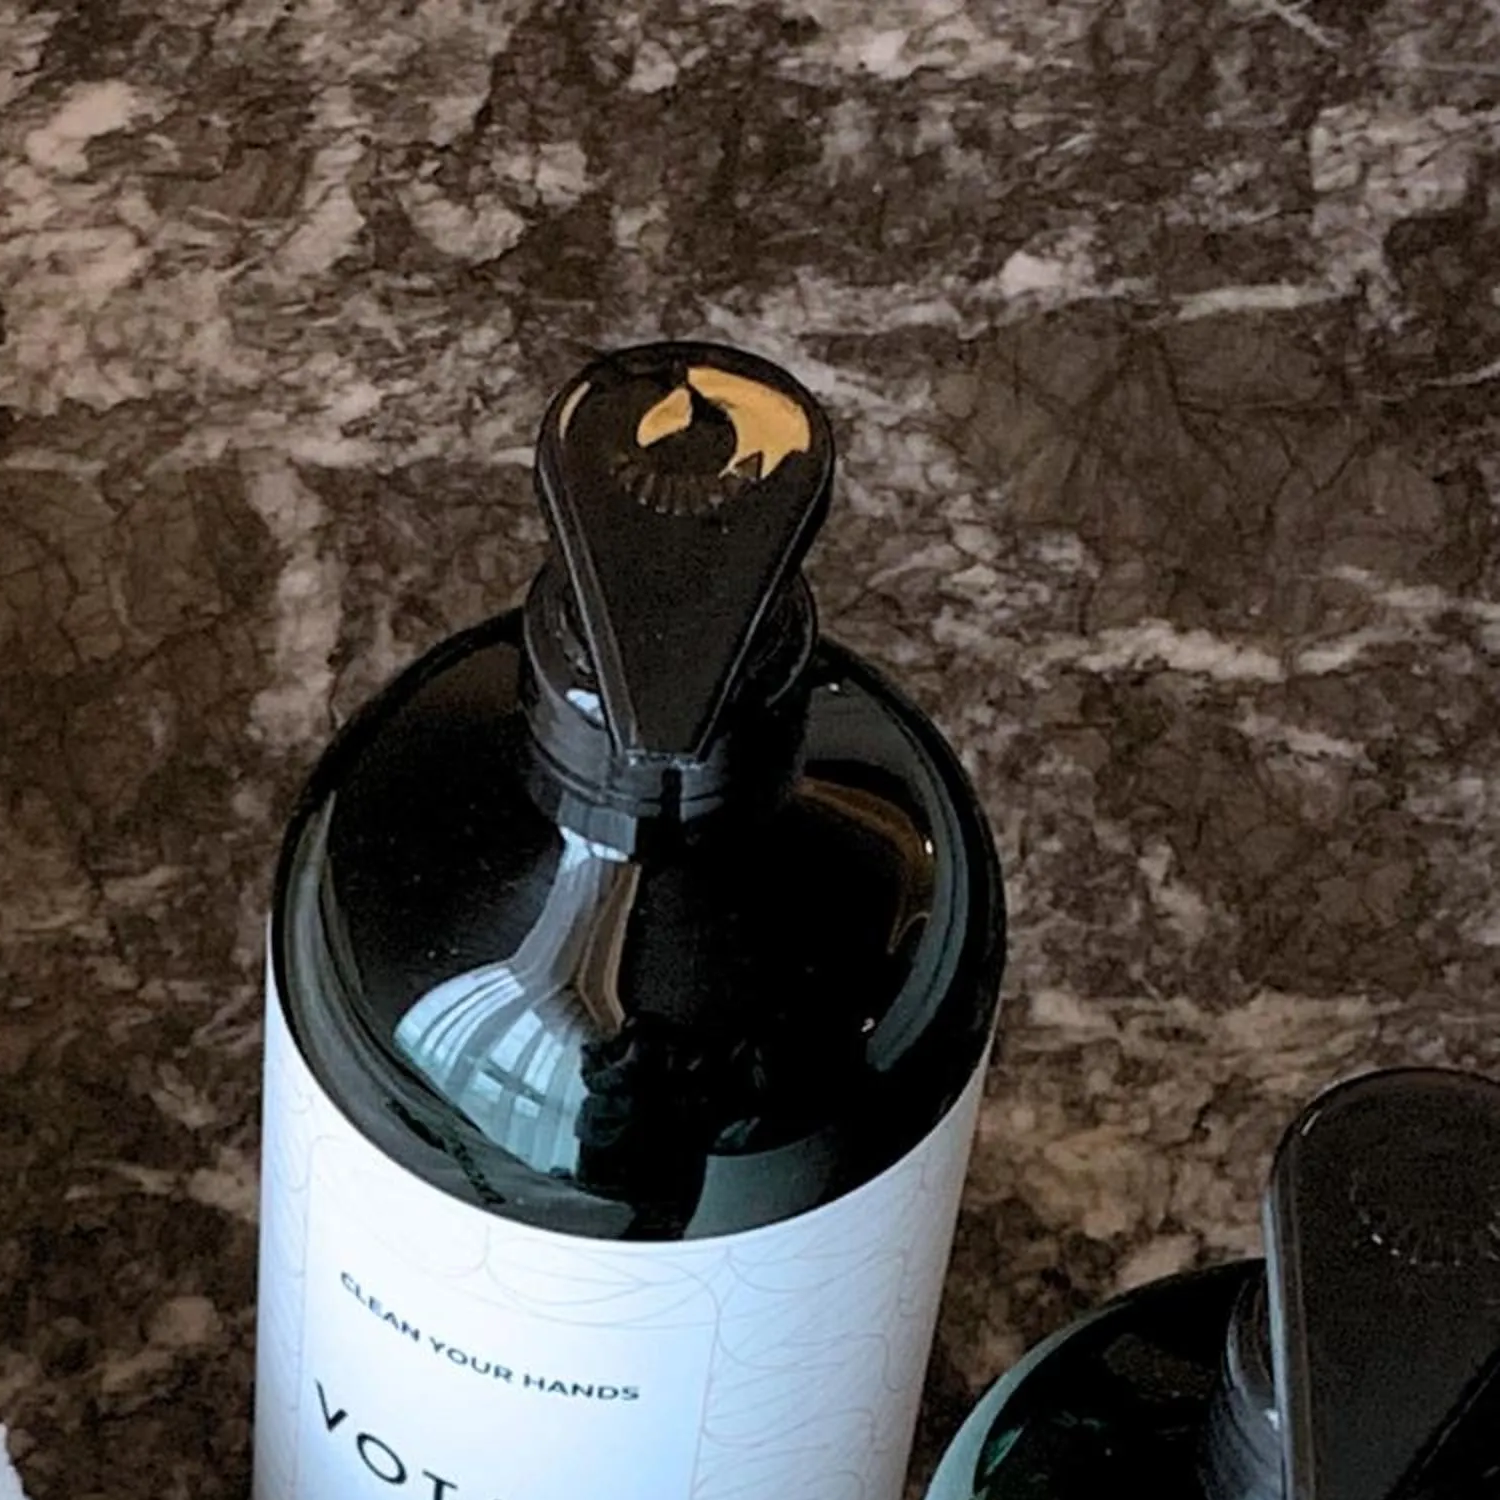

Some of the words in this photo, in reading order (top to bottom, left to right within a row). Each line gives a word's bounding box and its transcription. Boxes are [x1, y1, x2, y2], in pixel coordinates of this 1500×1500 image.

[341, 1271, 420, 1341] CLEAN
[430, 1336, 513, 1383] YOUR
[523, 1373, 640, 1400] HANDS
